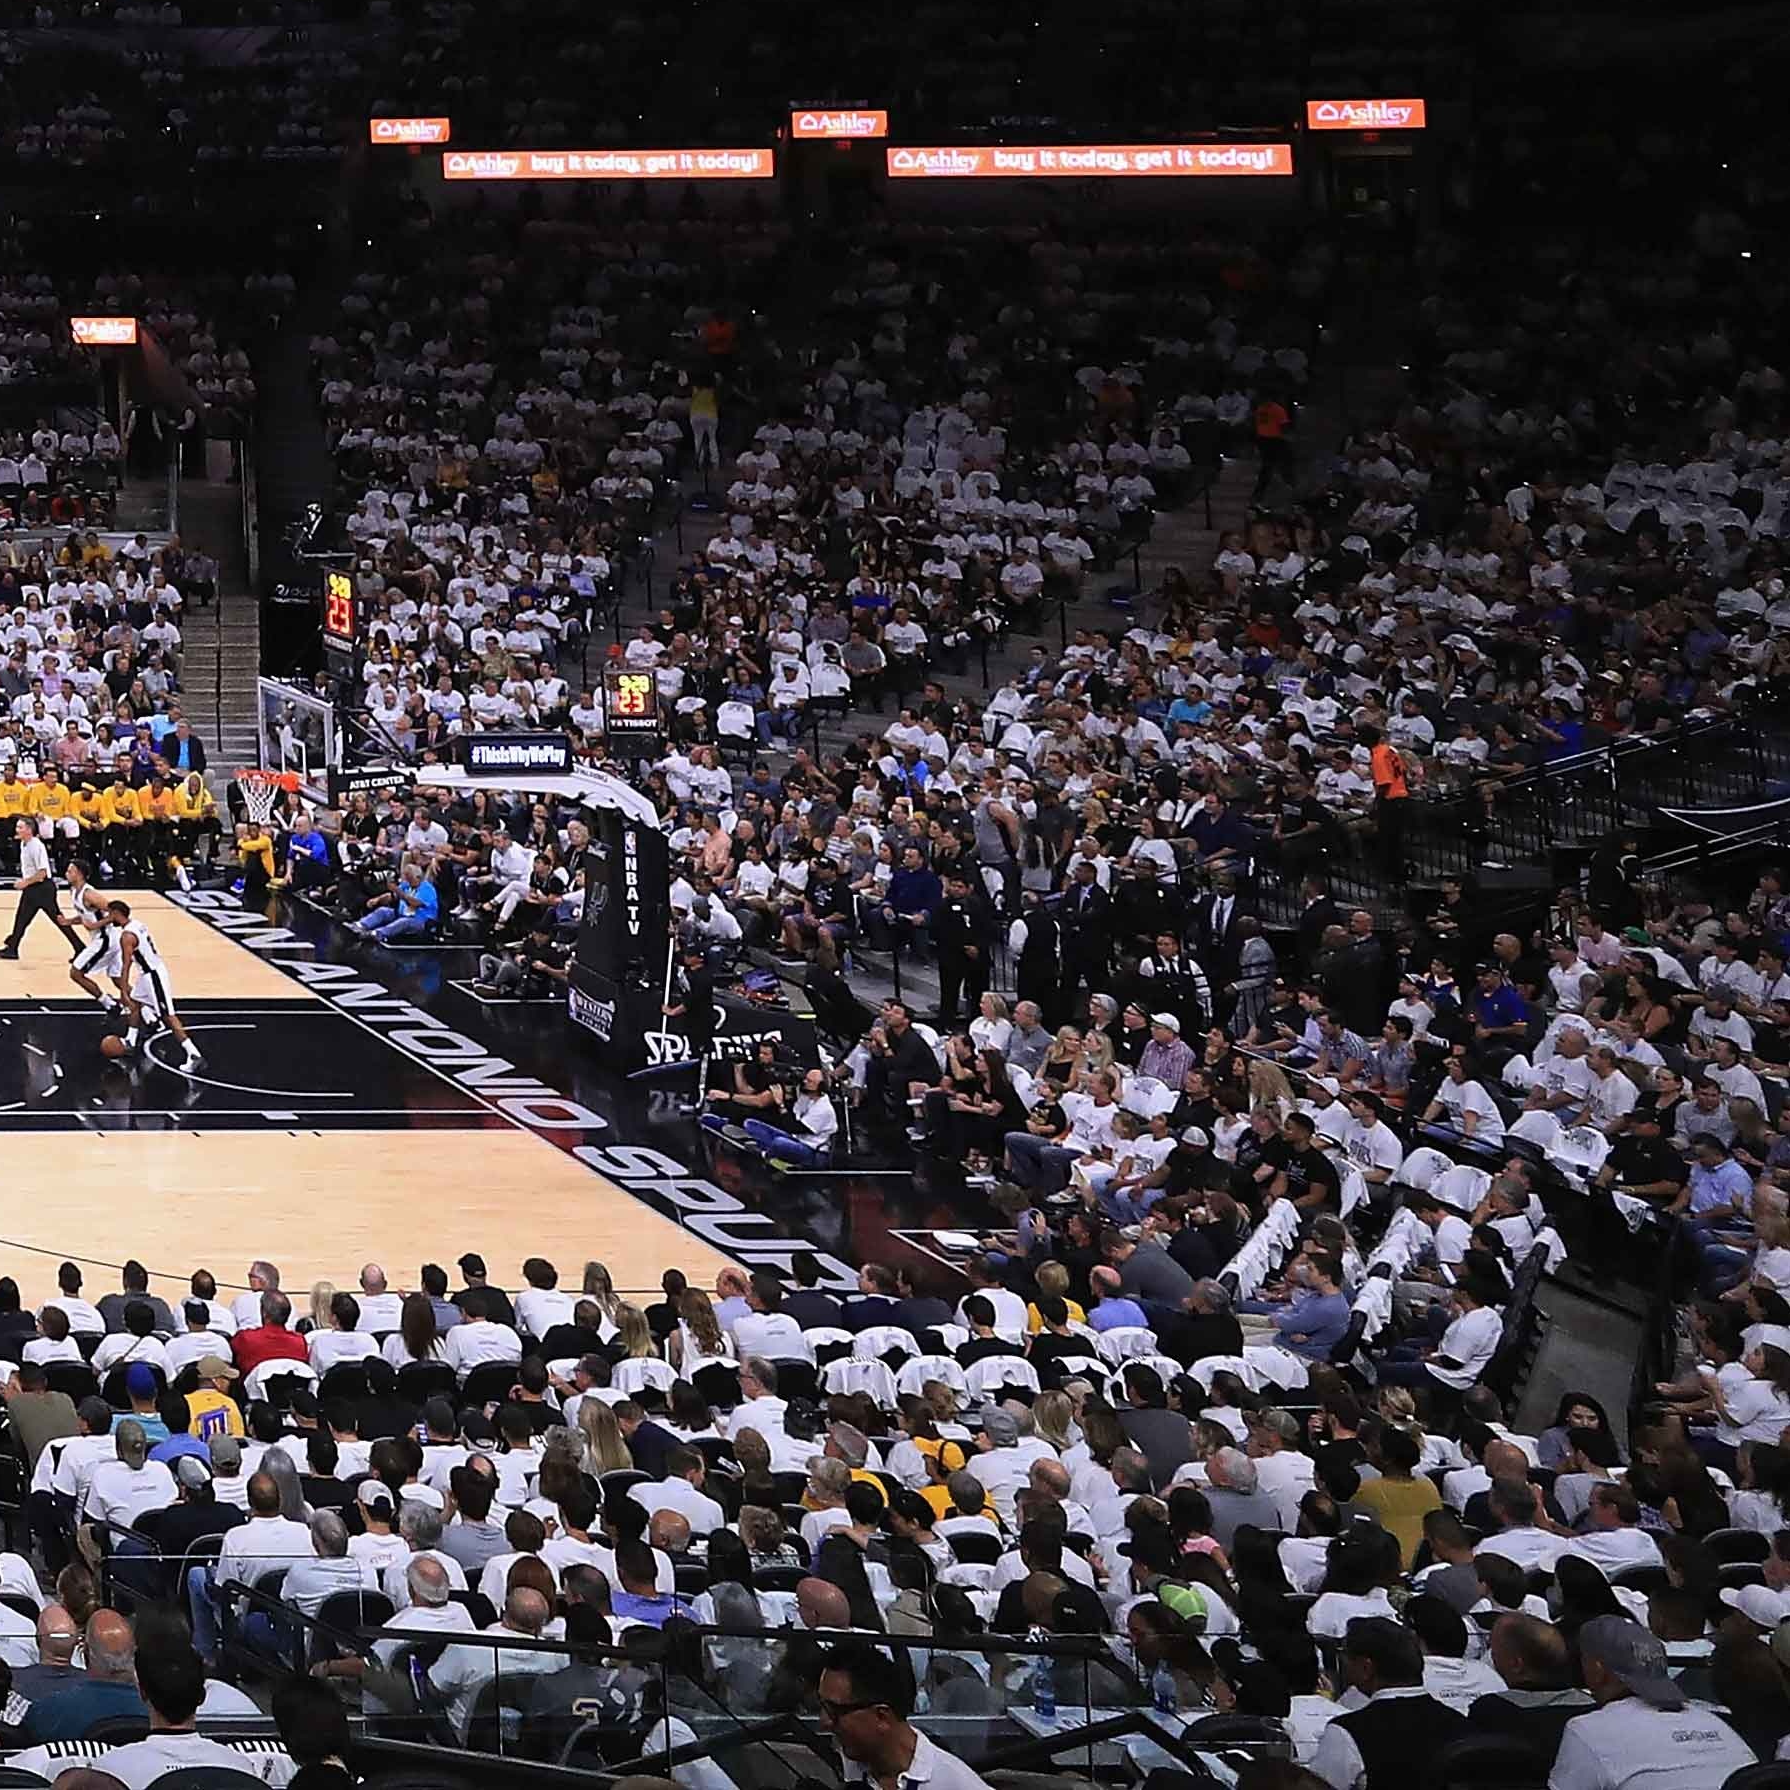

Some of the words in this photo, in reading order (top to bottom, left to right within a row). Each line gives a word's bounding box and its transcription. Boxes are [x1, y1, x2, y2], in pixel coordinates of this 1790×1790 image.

[816, 113, 877, 132] Ashley
[1340, 102, 1412, 123] Ashley
[390, 121, 441, 138] Ashley
[466, 154, 519, 173] Ashley
[530, 153, 565, 173] buy
[568, 153, 583, 168] it
[645, 155, 678, 173] get
[679, 153, 694, 168] it
[696, 152, 759, 172] today!
[916, 150, 978, 169] Ashley
[993, 150, 1036, 170] buy
[1038, 150, 1056, 167] it
[1134, 151, 1172, 170] get
[1176, 148, 1192, 166] it
[1198, 148, 1273, 169] today!
[349, 779, 370, 790] AT&T
[371, 776, 405, 788] CENTER
[624, 857, 640, 902] NBA
[627, 905, 641, 936] TV
[163, 889, 317, 950] SAN
[272, 957, 609, 1131] ANTONIO
